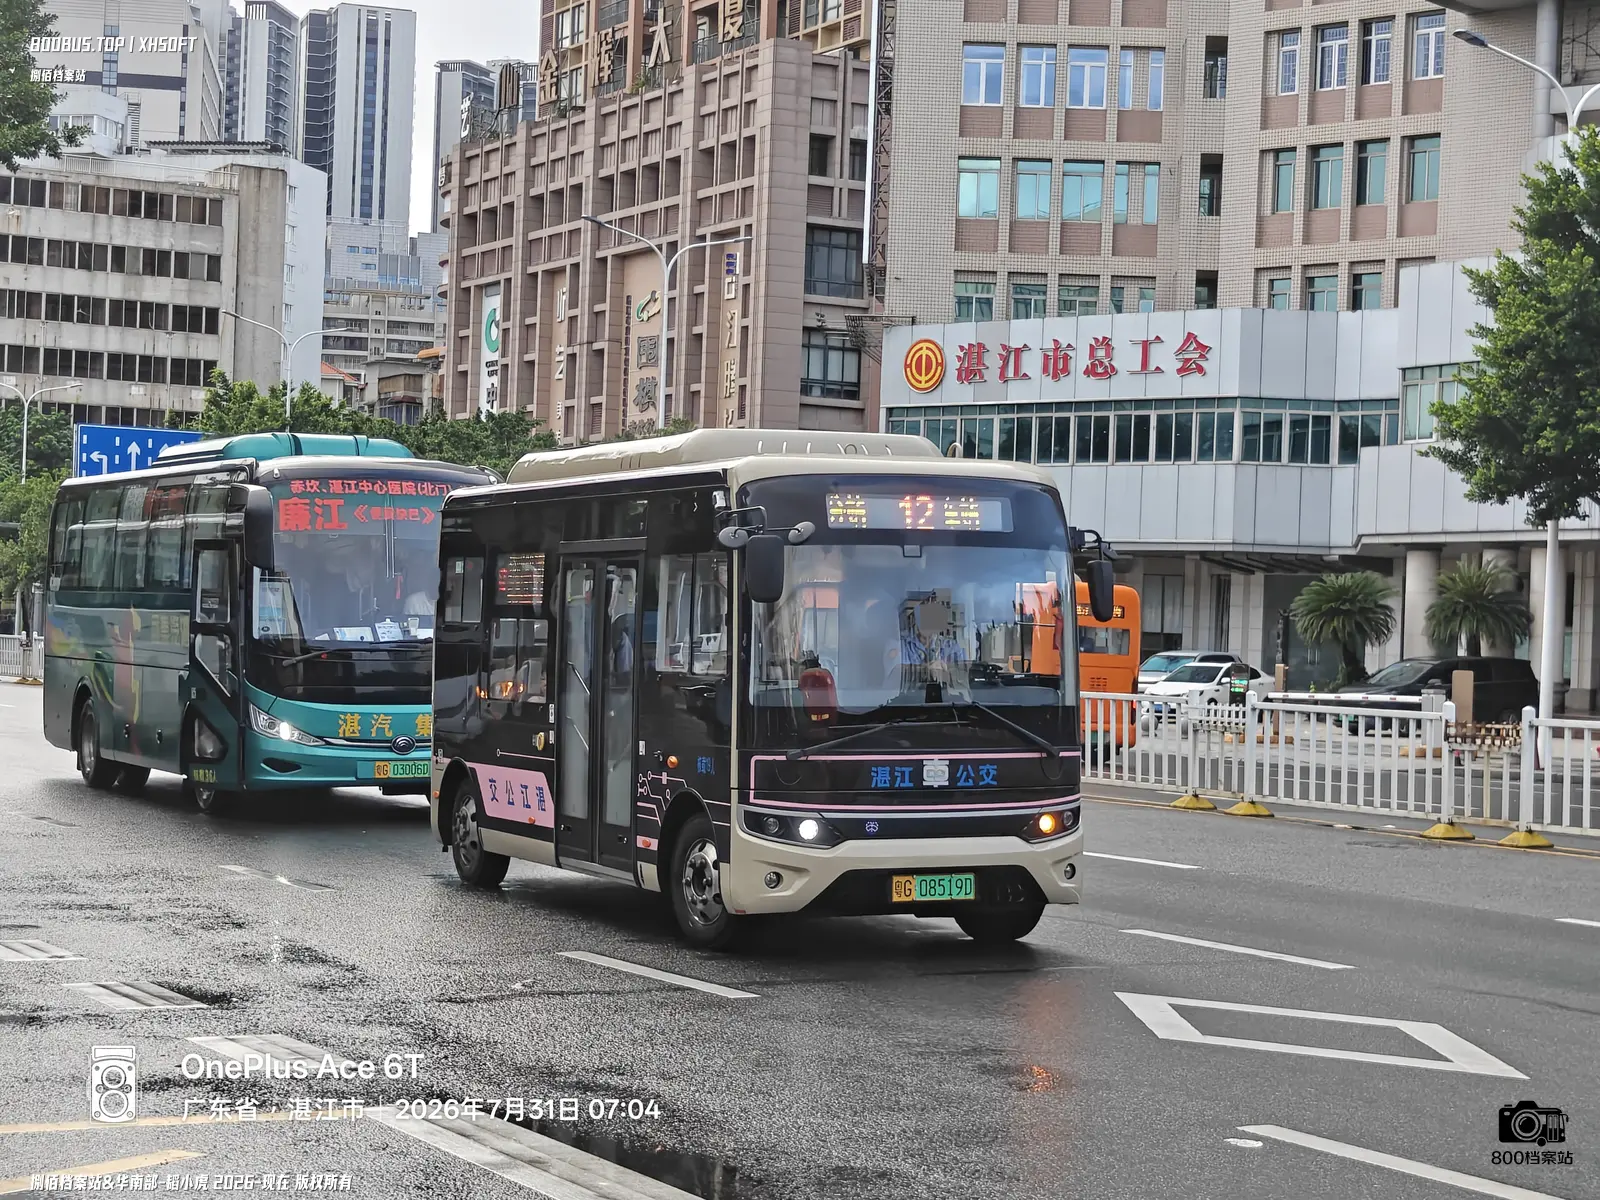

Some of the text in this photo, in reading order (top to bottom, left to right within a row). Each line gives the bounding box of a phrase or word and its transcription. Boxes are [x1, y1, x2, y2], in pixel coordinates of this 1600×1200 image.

[954, 331, 1213, 385] 湛江市总工会
[278, 497, 348, 532] 廉江
[898, 495, 935, 530] 12
[871, 764, 998, 788] 湛江 公交
